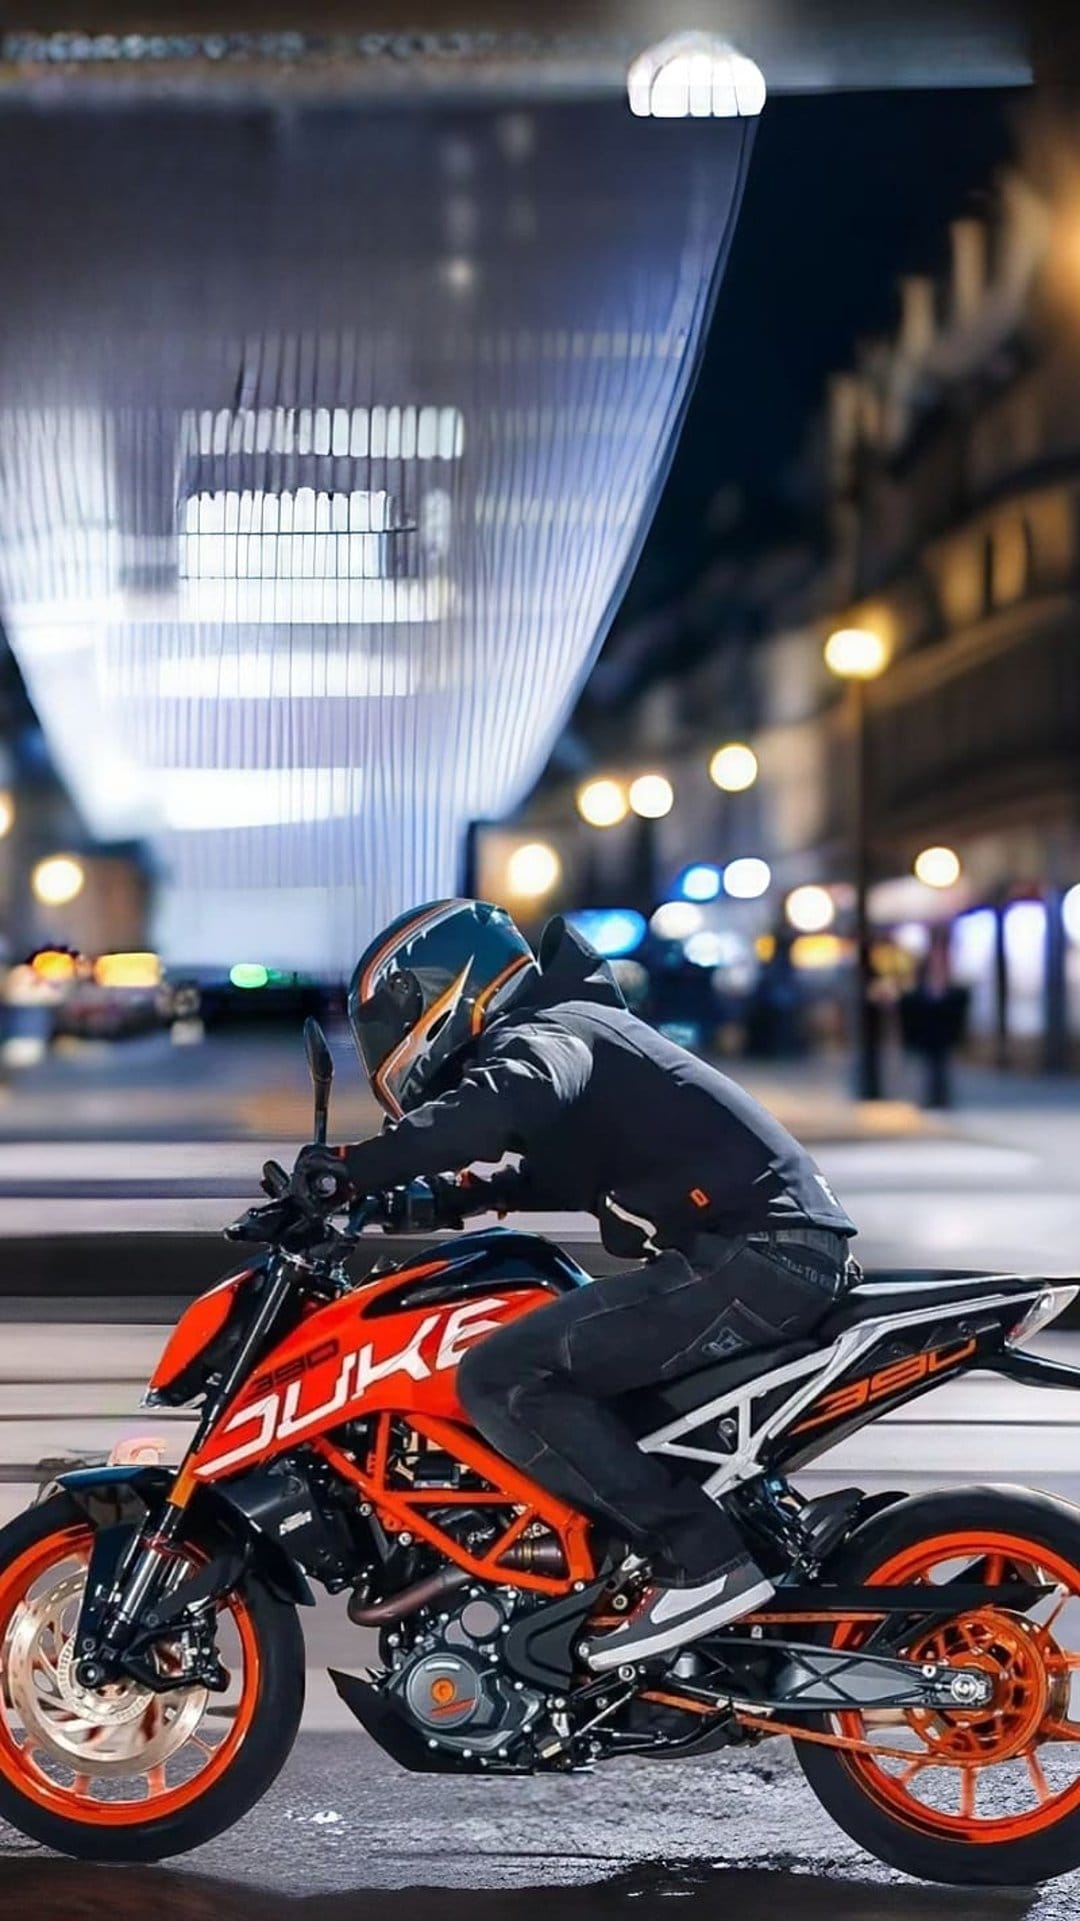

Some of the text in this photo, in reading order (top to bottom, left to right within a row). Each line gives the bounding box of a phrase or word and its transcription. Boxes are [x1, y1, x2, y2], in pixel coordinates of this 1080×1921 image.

[194, 1298, 508, 1477] DUKE
[243, 1338, 339, 1402] 390
[788, 1336, 977, 1436] 390
